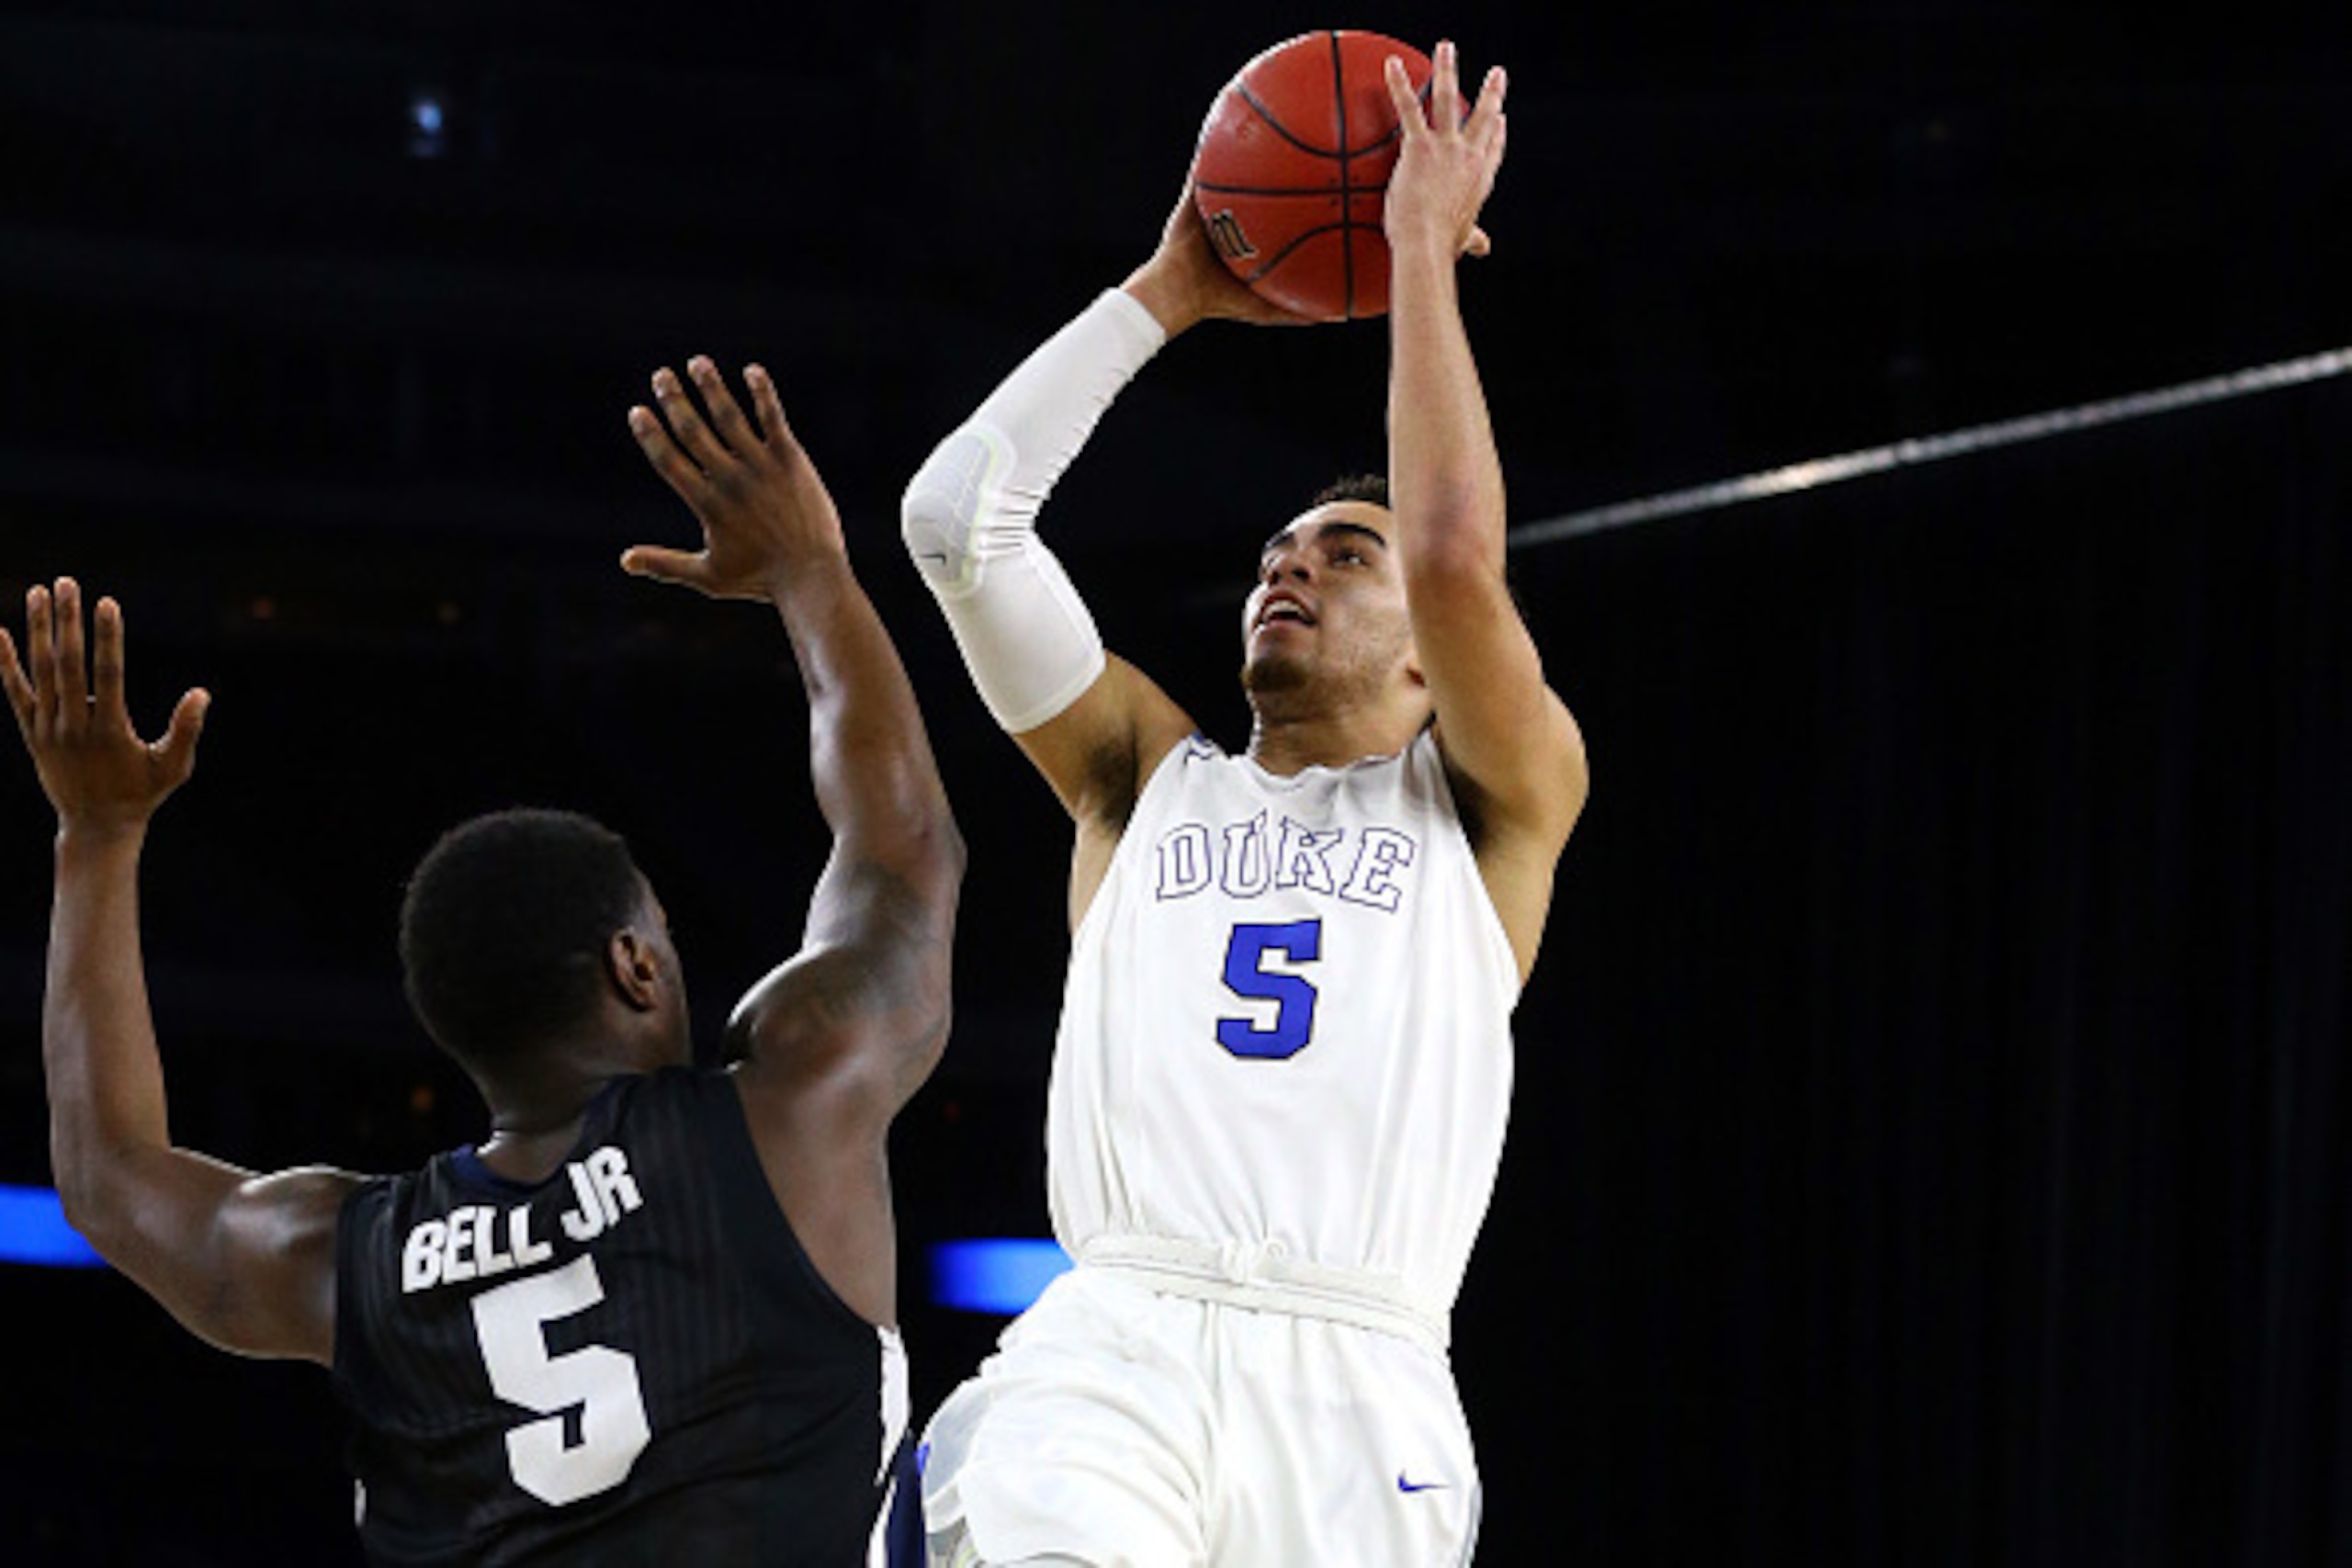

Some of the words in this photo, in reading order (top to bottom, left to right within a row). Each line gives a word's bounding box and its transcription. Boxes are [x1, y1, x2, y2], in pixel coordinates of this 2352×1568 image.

[1156, 808, 1417, 914] DUKE
[1216, 918, 1323, 1061] 5
[401, 1203, 553, 1294] BELL
[560, 1145, 645, 1243] JR
[469, 1254, 651, 1506] 5
